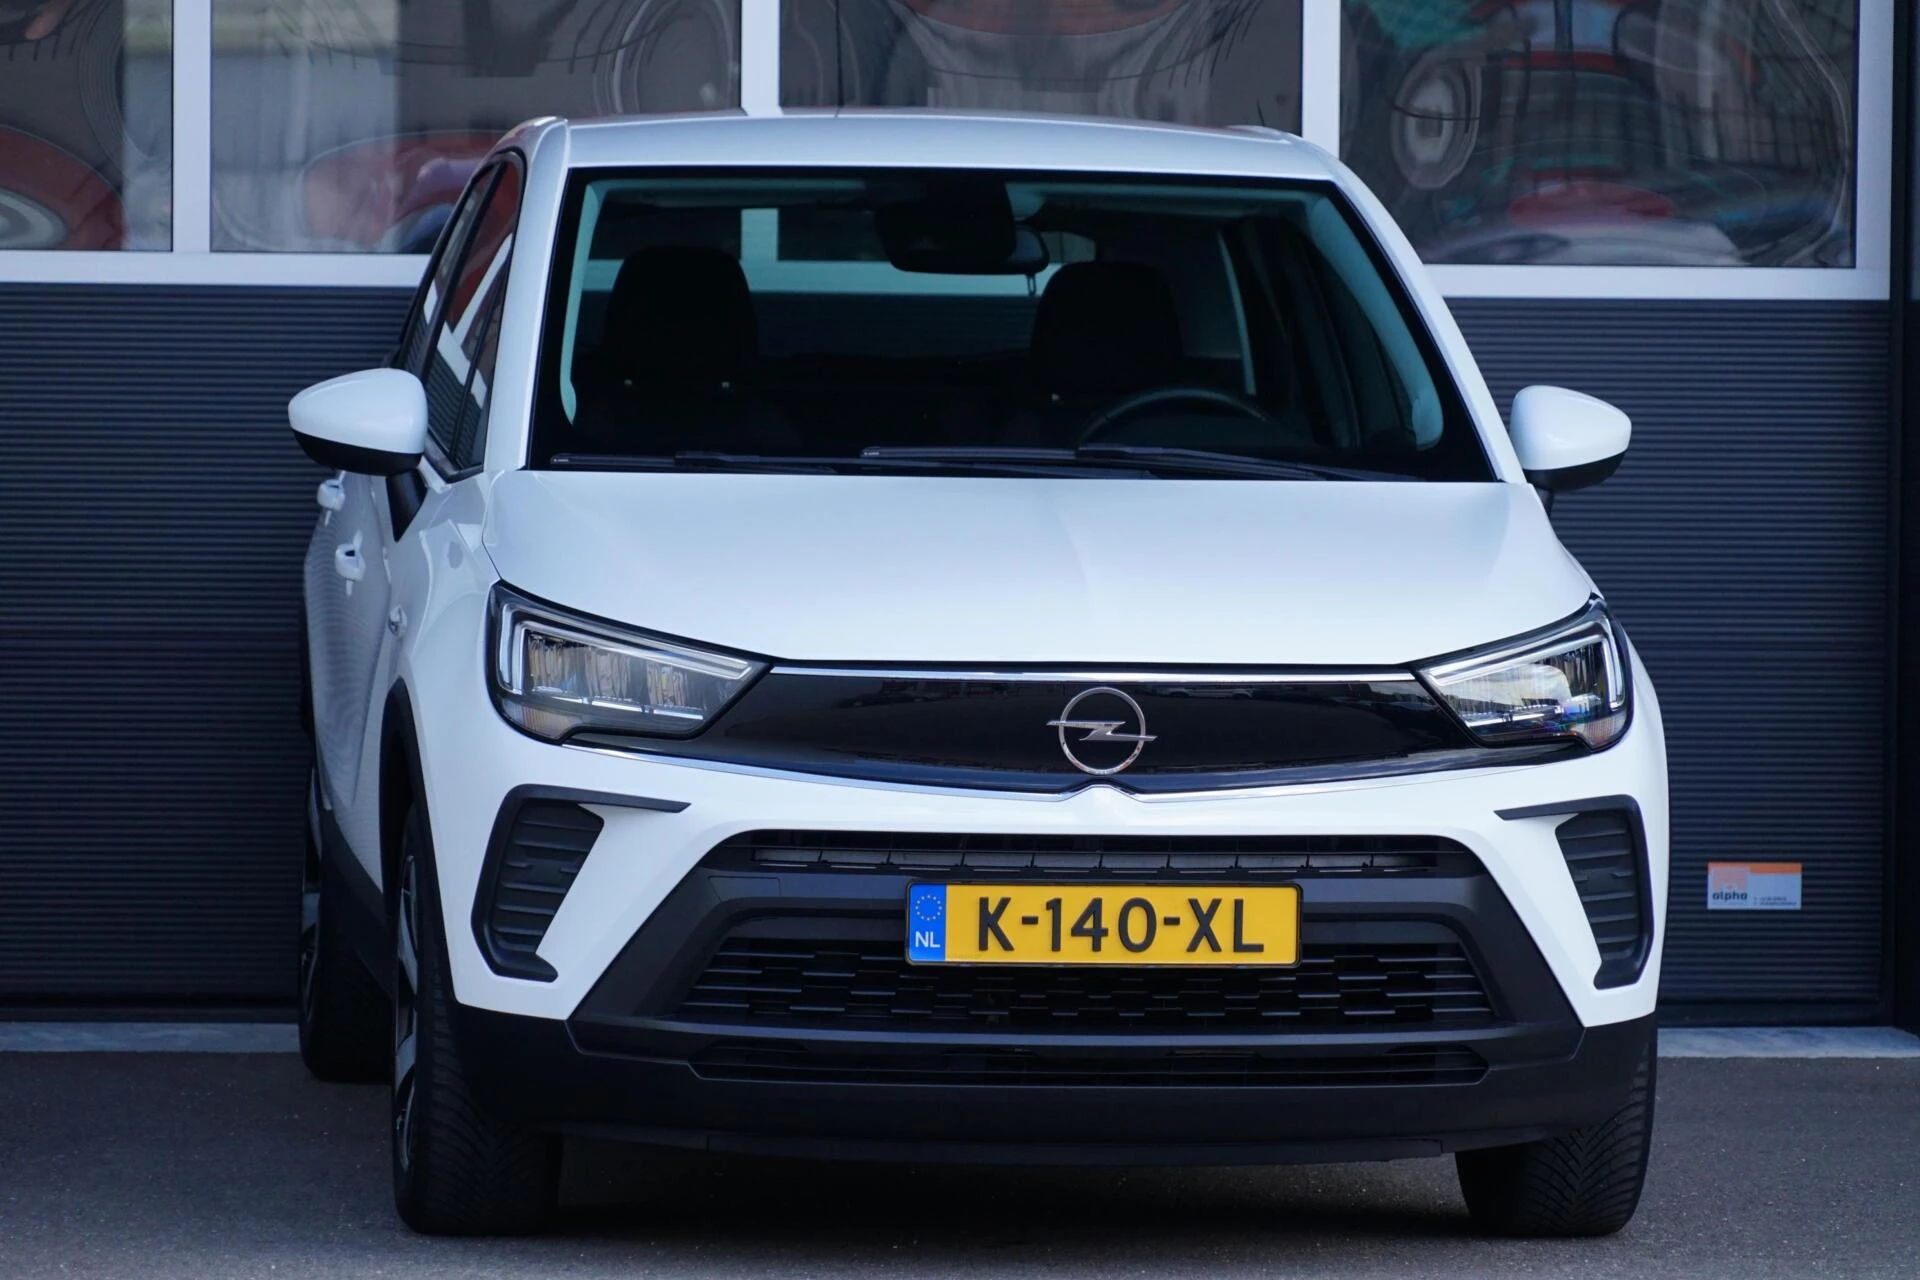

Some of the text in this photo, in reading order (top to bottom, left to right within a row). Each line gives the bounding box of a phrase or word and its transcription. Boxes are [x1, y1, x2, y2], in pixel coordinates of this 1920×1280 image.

[1712, 890, 1748, 902] alpha
[978, 896, 1265, 953] K-140-XL
[914, 930, 942, 949] NL
